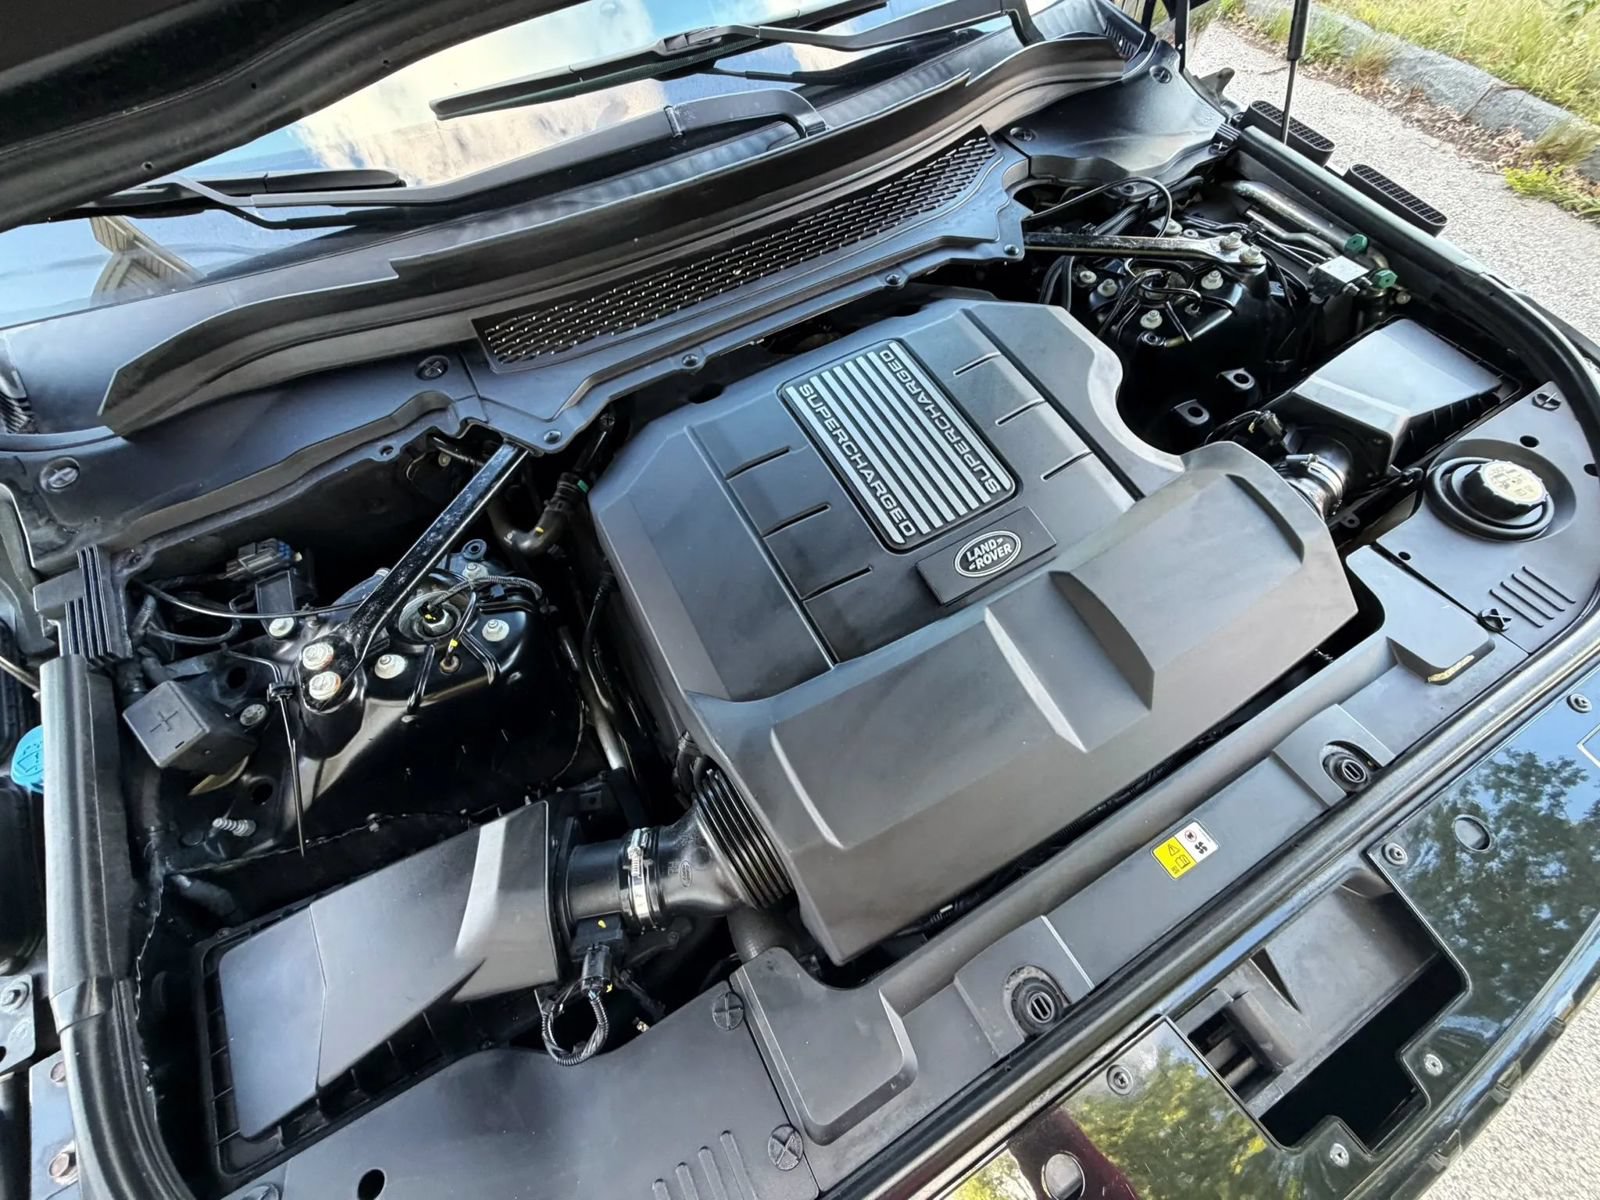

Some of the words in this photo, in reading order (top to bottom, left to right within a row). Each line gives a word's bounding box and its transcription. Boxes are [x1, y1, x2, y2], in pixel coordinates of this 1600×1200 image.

[800, 382, 916, 538] SUPERCHARGED
[879, 350, 1001, 494] SUPERCHARGED
[966, 538, 998, 562] LAND
[975, 542, 1013, 570] ROVER
